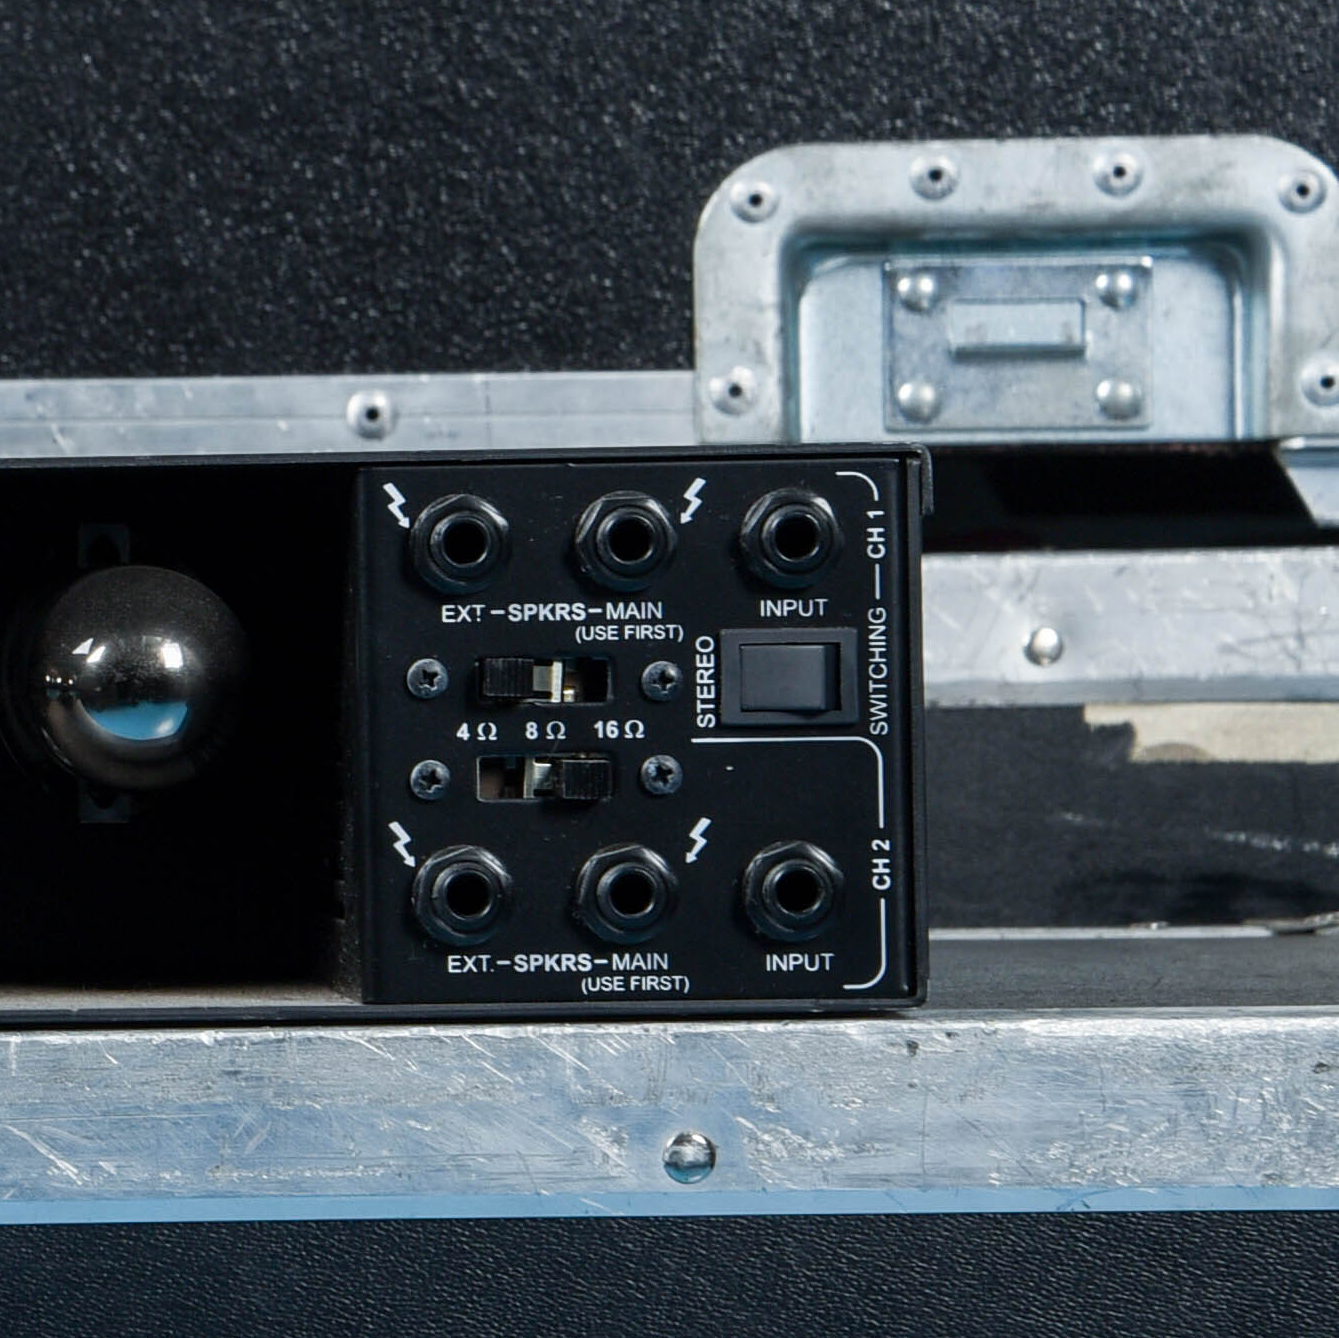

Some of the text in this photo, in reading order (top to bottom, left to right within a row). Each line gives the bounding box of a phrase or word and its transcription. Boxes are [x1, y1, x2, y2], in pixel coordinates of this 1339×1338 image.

[866, 510, 886, 558] CH 1
[761, 599, 827, 617] INPUT
[576, 625, 683, 643] (USE FIRST)
[696, 636, 715, 727] STEREO
[868, 608, 888, 735] SWITCHING
[871, 839, 891, 890] CH 2
[767, 953, 834, 971] INPUT
[582, 976, 689, 995] (USE FIRST)
